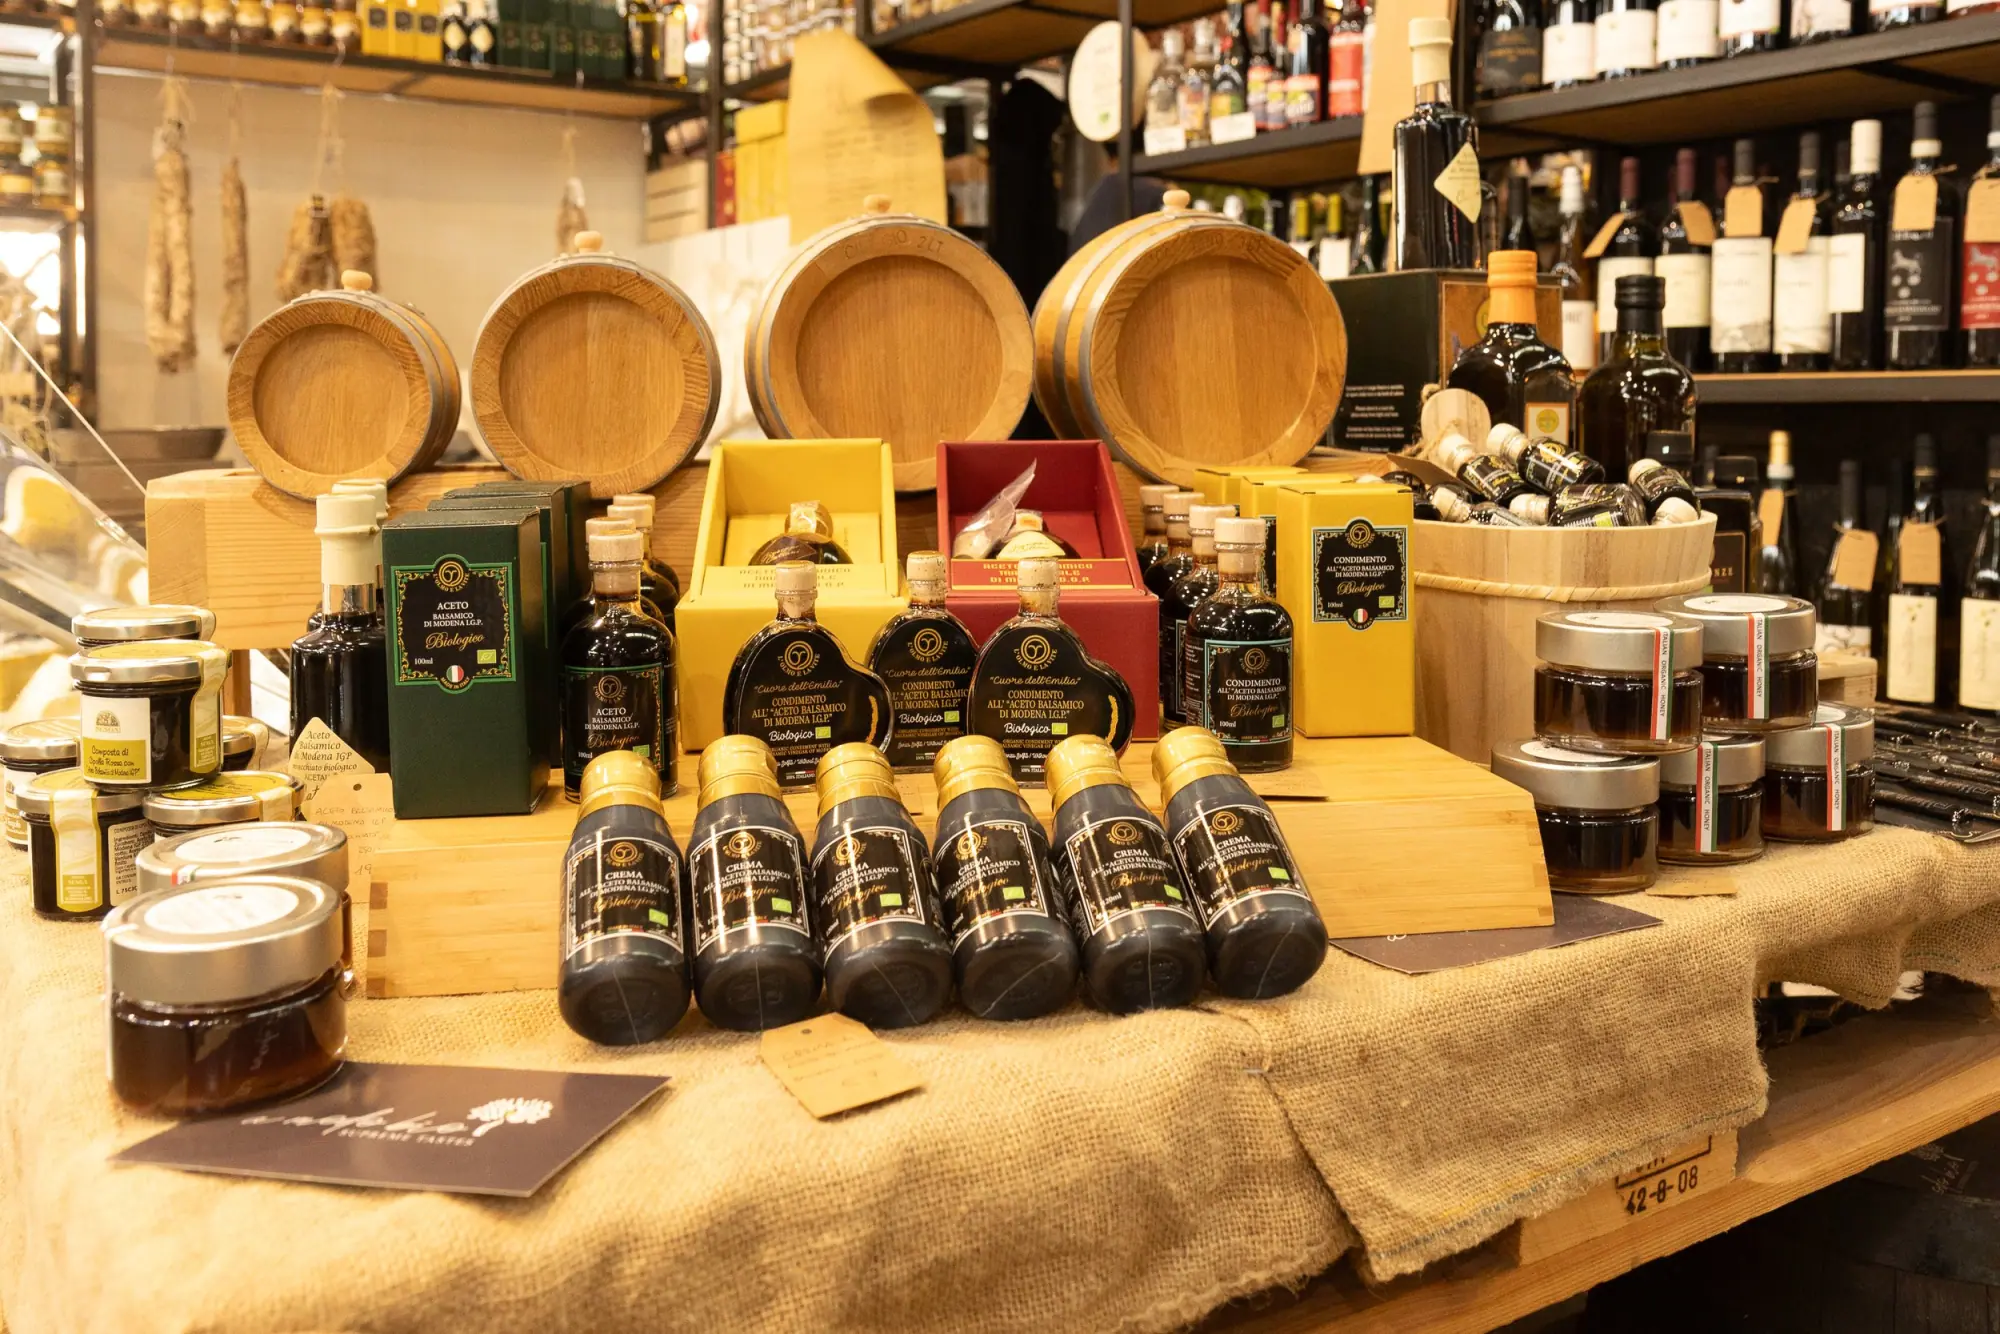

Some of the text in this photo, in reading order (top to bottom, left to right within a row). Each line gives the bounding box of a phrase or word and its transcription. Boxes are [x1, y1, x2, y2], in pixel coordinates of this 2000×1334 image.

[1337, 580, 1384, 598] Biologico
[437, 602, 468, 610] ACETO
[426, 632, 484, 651] Biologico
[1014, 648, 1032, 670] L'OLMO
[902, 680, 954, 690] CONDIMENTO
[1226, 678, 1280, 687] CONDIMENTO
[931, 689, 968, 698] BALSAMIC
[1008, 690, 1064, 699] CONDIMENTO
[772, 694, 826, 706] CONDIMENTO
[894, 701, 904, 710] DI
[906, 700, 940, 709] MODENA
[988, 700, 1004, 708] ALL'
[1038, 700, 1084, 710] BALSAMICO
[596, 708, 626, 716] ACETO
[801, 703, 846, 714] BALSAMICO
[1000, 710, 1008, 718] DI
[1010, 710, 1046, 718] MODENA
[764, 718, 773, 728] DI
[775, 716, 810, 726] MODENA
[899, 714, 944, 724] Biologico
[1004, 722, 1050, 736] Biologico
[306, 730, 330, 740] Aceto
[769, 730, 814, 742] Biologico
[92, 744, 120, 758] Composta
[299, 741, 341, 750] Balsamico
[300, 752, 353, 762] Modena IGP
[324, 764, 357, 773] biologico
[1216, 836, 1252, 850] CREMA
[1238, 842, 1278, 854] BALSAMICO
[1114, 850, 1149, 858] CREMA
[726, 861, 763, 872] CREMA
[958, 856, 991, 876] CREMA
[1110, 862, 1146, 873] MODENA
[1136, 858, 1173, 870] BALSAMICO
[1208, 862, 1216, 870] DI
[605, 871, 643, 880] CREMA
[748, 869, 790, 880] BALSAMICO
[836, 862, 868, 881] CREMA
[599, 885, 636, 895] MODENA
[627, 880, 670, 894] BALSAMICO
[1626, 1165, 1698, 1216] 42-8-08
